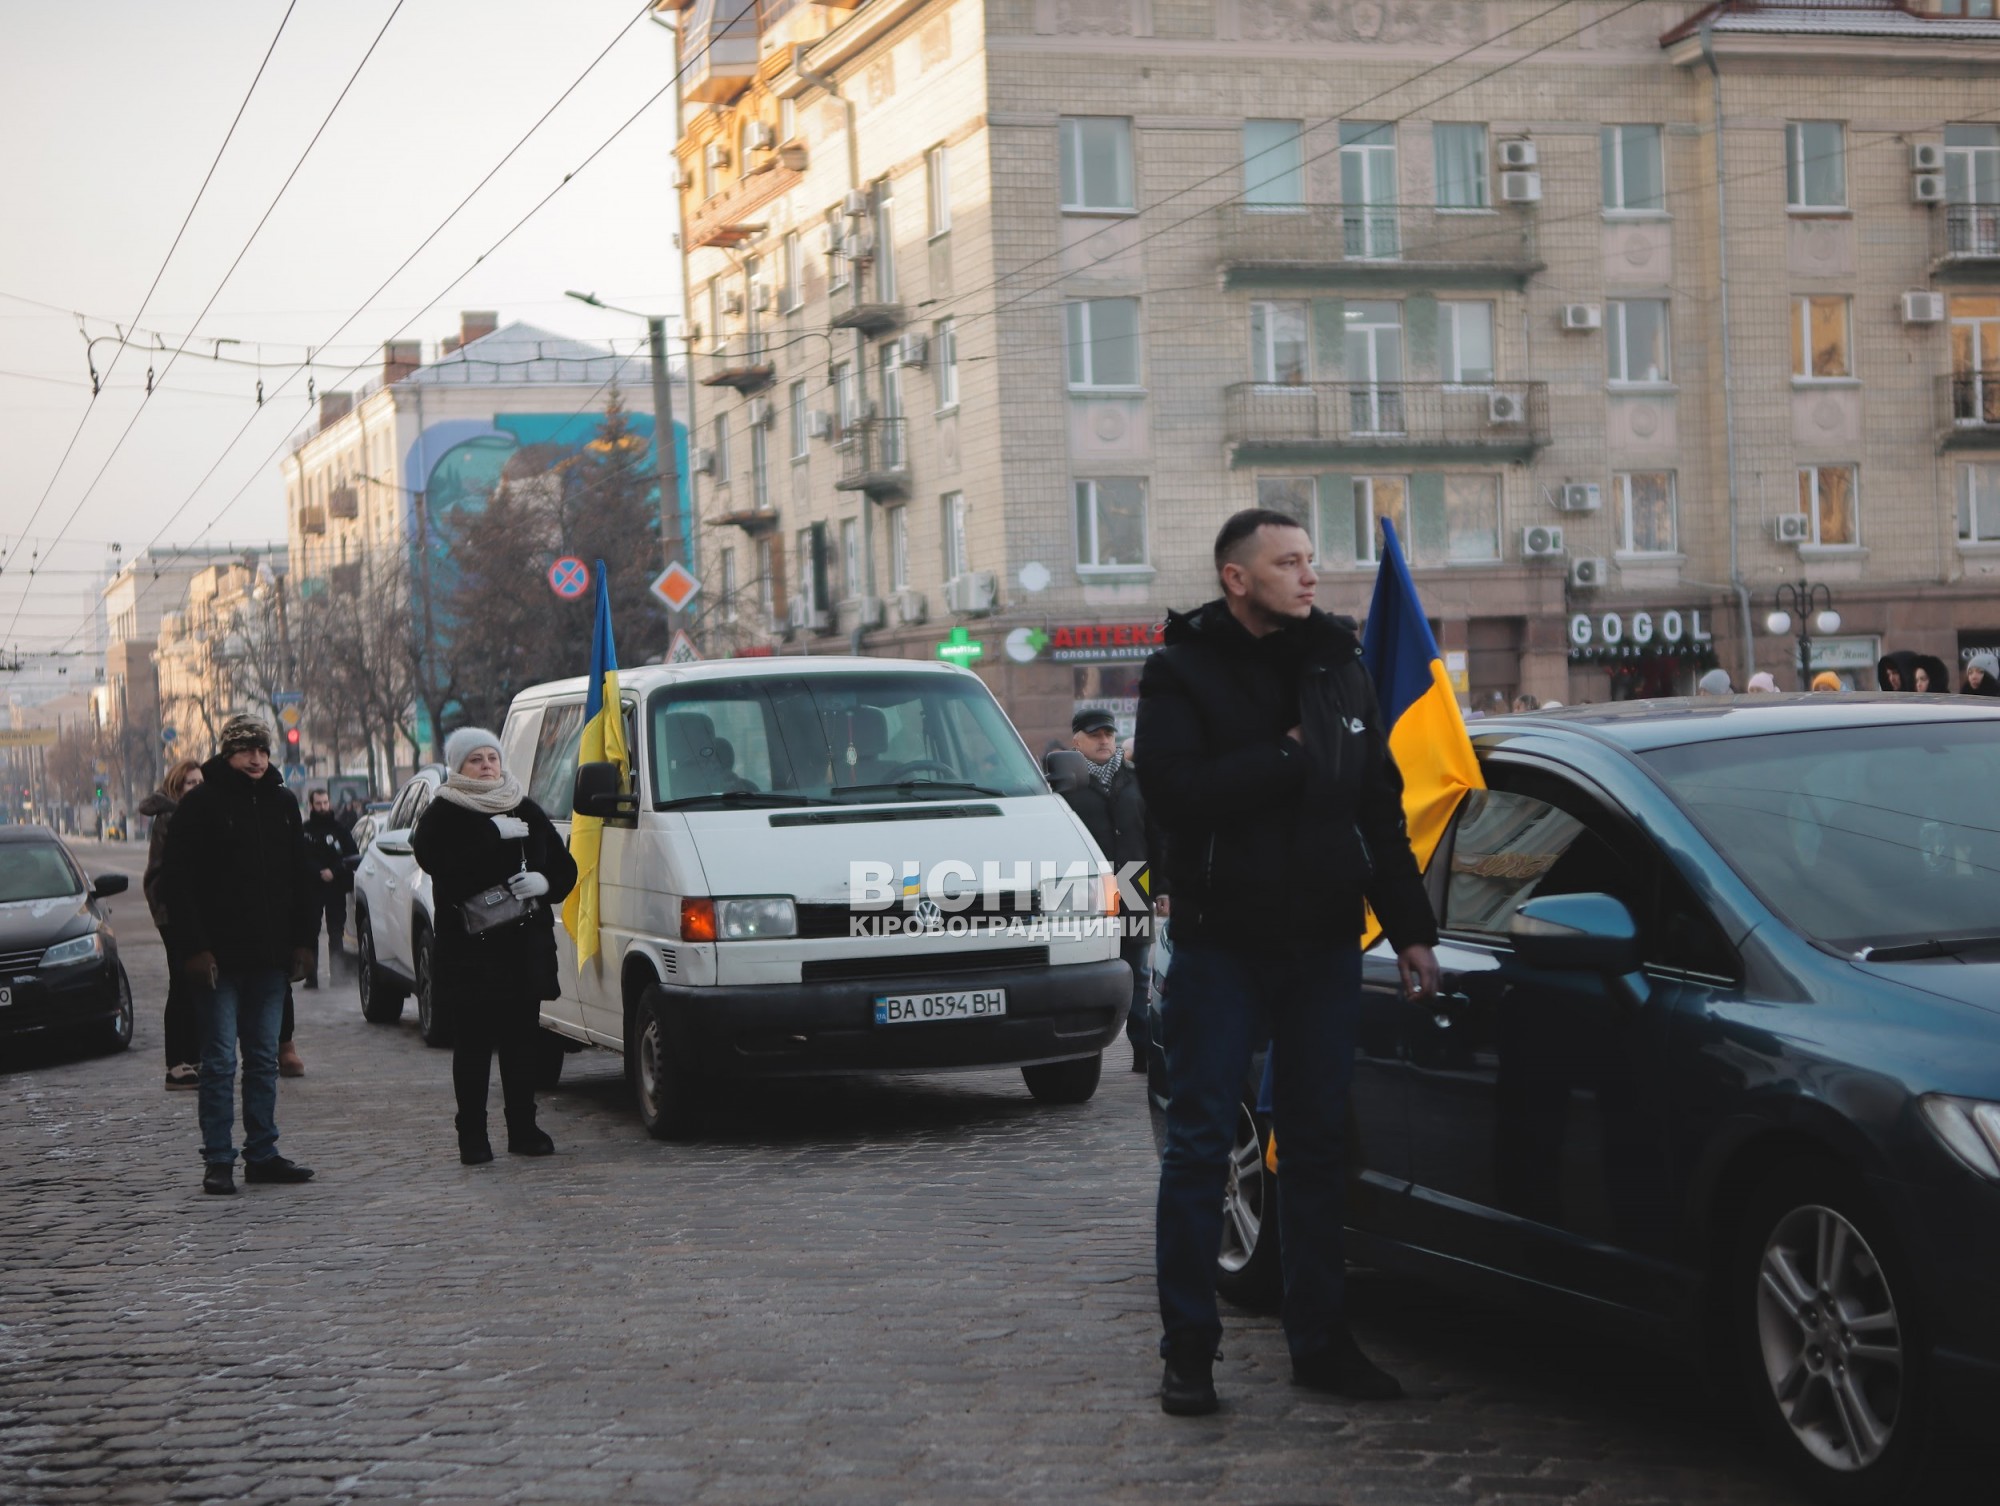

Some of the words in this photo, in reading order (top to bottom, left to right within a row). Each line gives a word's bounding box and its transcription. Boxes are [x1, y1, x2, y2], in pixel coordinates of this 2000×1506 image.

[1053, 623, 1165, 649] АПТЕКА
[1571, 609, 1712, 645] GOGOL
[1055, 649, 1107, 660] ГОЛОВНА
[1111, 647, 1154, 658] АПТЕКА
[888, 999, 917, 1020] BA
[922, 995, 968, 1017] 0594
[973, 992, 1001, 1014] BH
